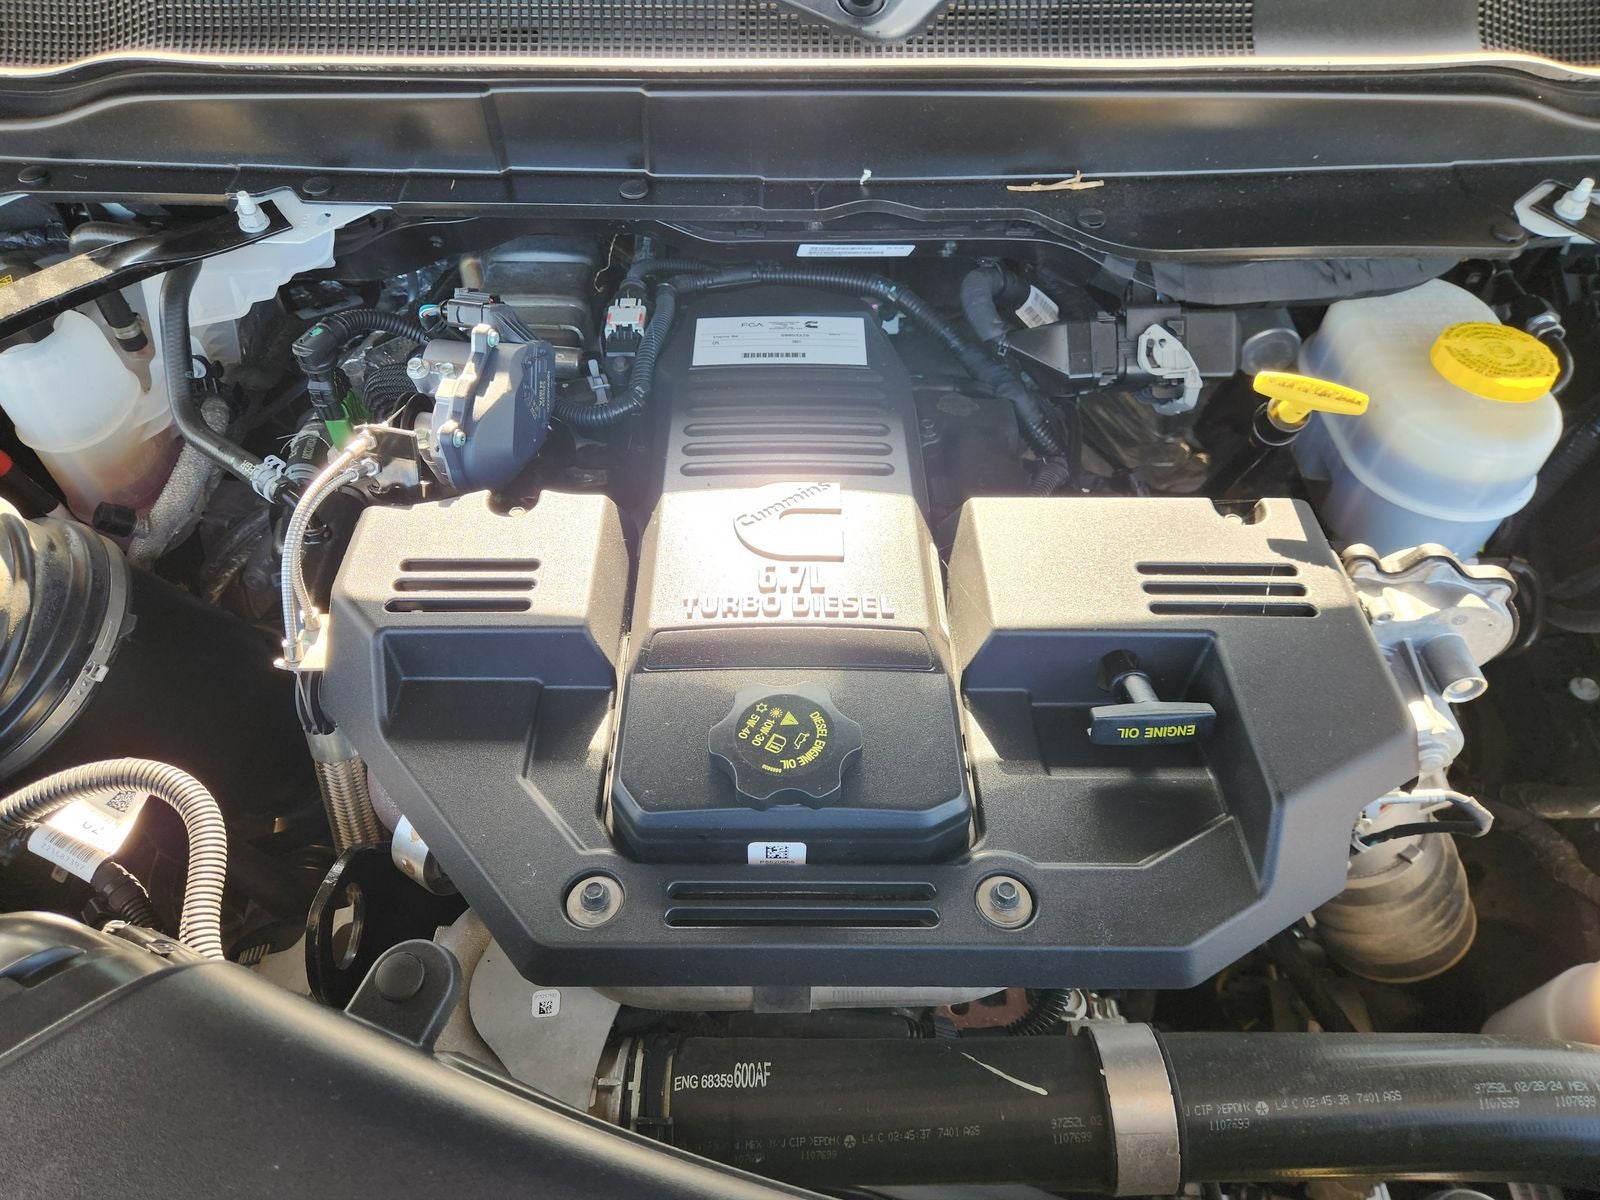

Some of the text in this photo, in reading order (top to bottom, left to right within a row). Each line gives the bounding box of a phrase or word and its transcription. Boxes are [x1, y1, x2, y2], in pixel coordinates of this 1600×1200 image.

[736, 482, 831, 526] Cummins
[758, 566, 826, 594] 6.7L
[682, 597, 895, 619] TURBO DIESEL
[738, 714, 760, 739] 5W-40
[751, 719, 775, 746] 10W-30
[1117, 724, 1196, 739] ENGINE OIL
[780, 711, 828, 769] DIESEL ENGINE OIL
[674, 1074, 699, 1092] ENG
[1194, 1104, 1213, 1116] CIP
[789, 1136, 806, 1148] CIP
[938, 1126, 959, 1138] 7401
[963, 1125, 980, 1136] AGS
